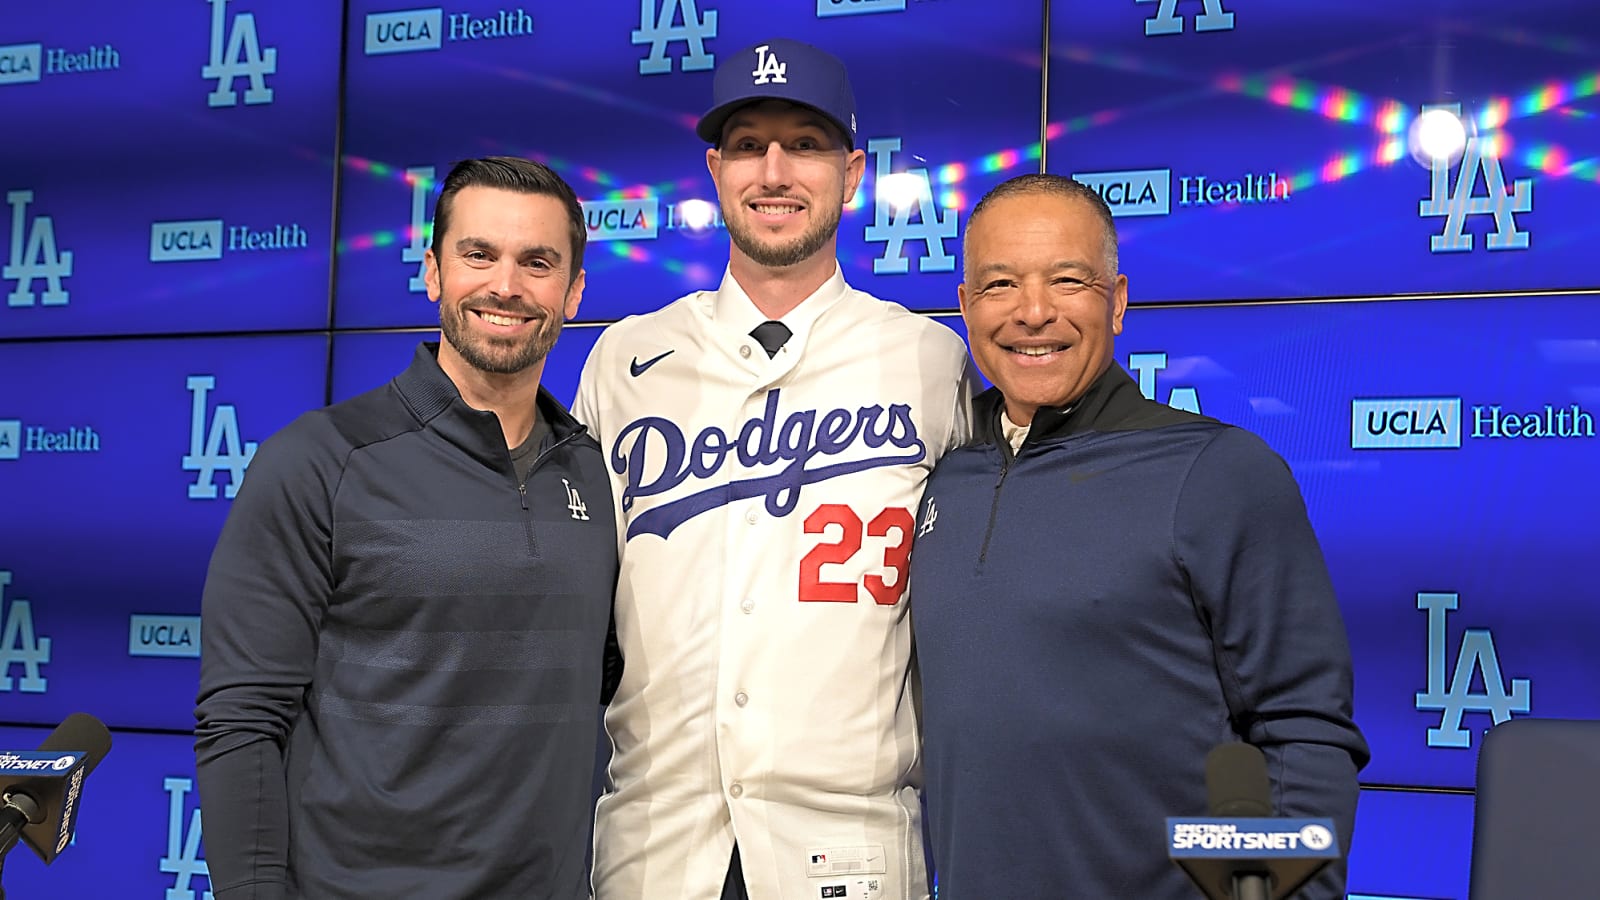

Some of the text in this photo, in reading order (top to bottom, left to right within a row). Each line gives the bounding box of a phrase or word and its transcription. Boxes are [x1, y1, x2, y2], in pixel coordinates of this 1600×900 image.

[376, 9, 533, 43] UCLA Health
[0, 45, 120, 75] CLA Health
[202, 0, 277, 107] LA
[752, 45, 787, 85] LA
[1178, 173, 1290, 206] Health
[1420, 104, 1532, 252] LA
[587, 208, 648, 232] UCLA
[865, 137, 958, 274] LA
[3, 190, 73, 306] LA
[161, 224, 308, 251] UCLA Health
[26, 427, 101, 451] Health
[182, 375, 258, 498] LA
[1367, 404, 1596, 438] UCLA Health
[611, 388, 927, 518] Dodgers
[561, 478, 590, 521] LA
[918, 496, 938, 538] LA
[799, 503, 915, 606] 23
[140, 625, 192, 646] UCLA
[1416, 592, 1530, 747] LA
[0, 760, 55, 770] RTSNET
[1173, 832, 1301, 849] SPORTSNET
